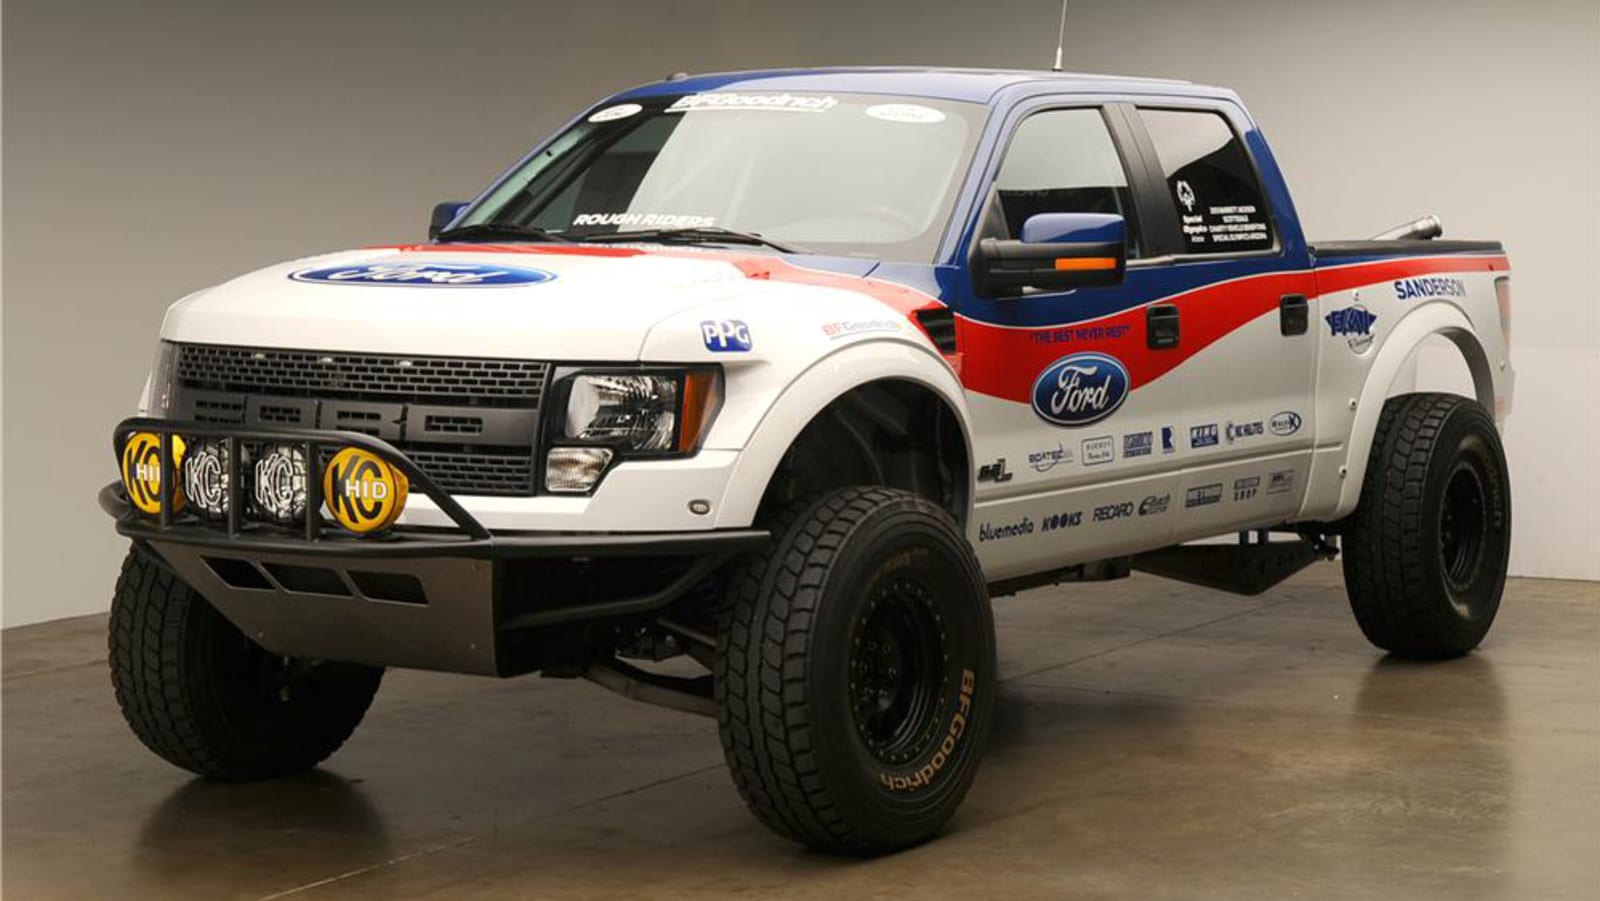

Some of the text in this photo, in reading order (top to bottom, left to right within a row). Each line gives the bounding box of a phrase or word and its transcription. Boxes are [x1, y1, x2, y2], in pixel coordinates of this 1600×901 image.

[573, 213, 716, 227] ROUGH RIDERS
[1394, 278, 1467, 300] SANDERSON
[703, 321, 749, 348] PPG
[1051, 365, 1112, 414] Ford
[136, 463, 161, 481] HI
[185, 451, 221, 509] KC
[255, 453, 293, 512] KC
[345, 479, 387, 499] HID
[1042, 512, 1083, 532] KOOKS
[1093, 502, 1134, 522] RECARO
[979, 517, 1034, 541] bluemedia
[879, 667, 976, 792] BFGoodrich
